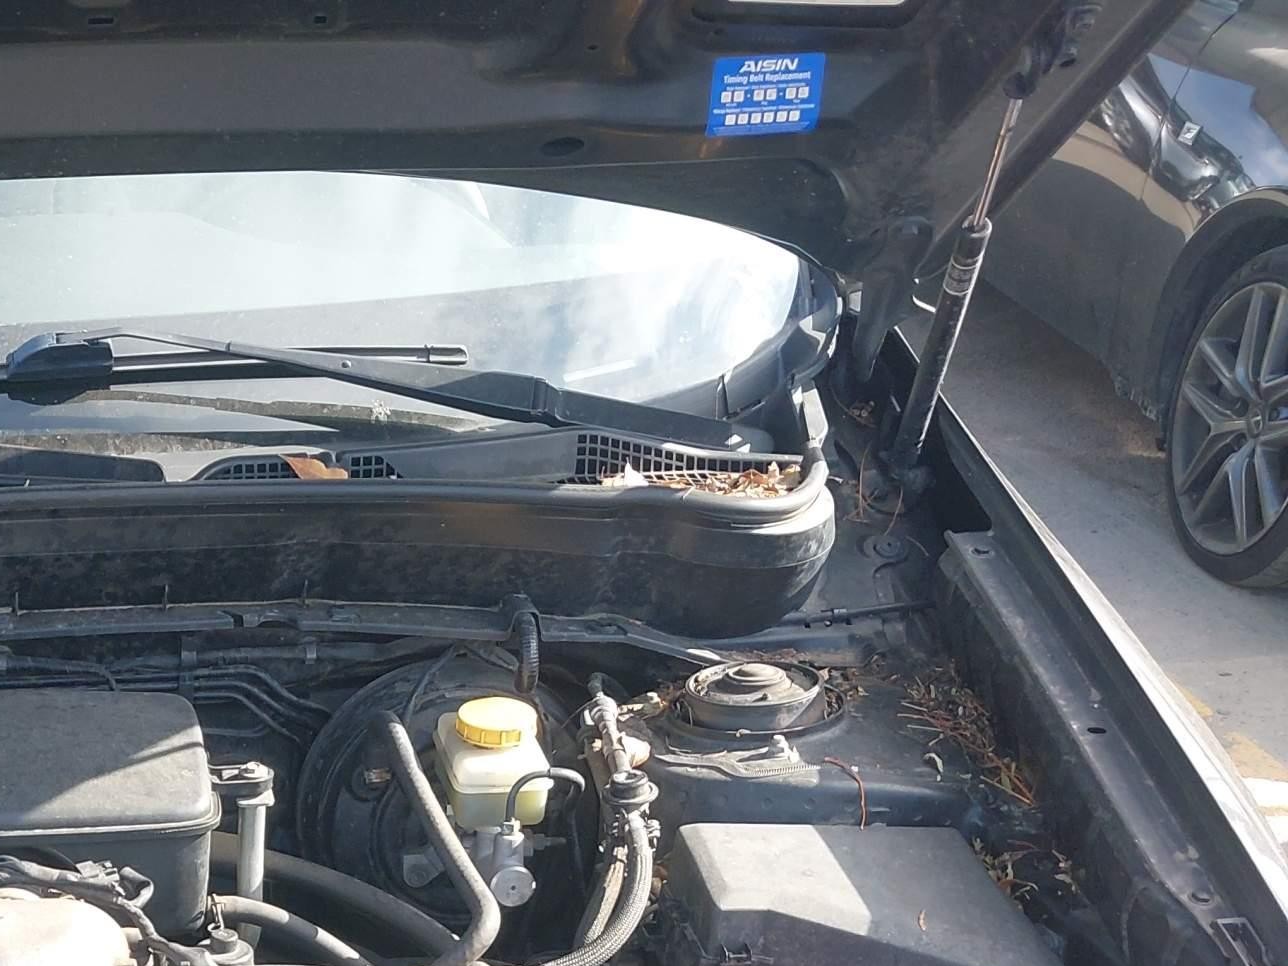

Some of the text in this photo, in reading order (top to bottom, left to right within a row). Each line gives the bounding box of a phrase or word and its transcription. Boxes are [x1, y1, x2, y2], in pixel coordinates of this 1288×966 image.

[739, 58, 799, 73] AISIN
[723, 71, 811, 85] Timing Belt Replacement
